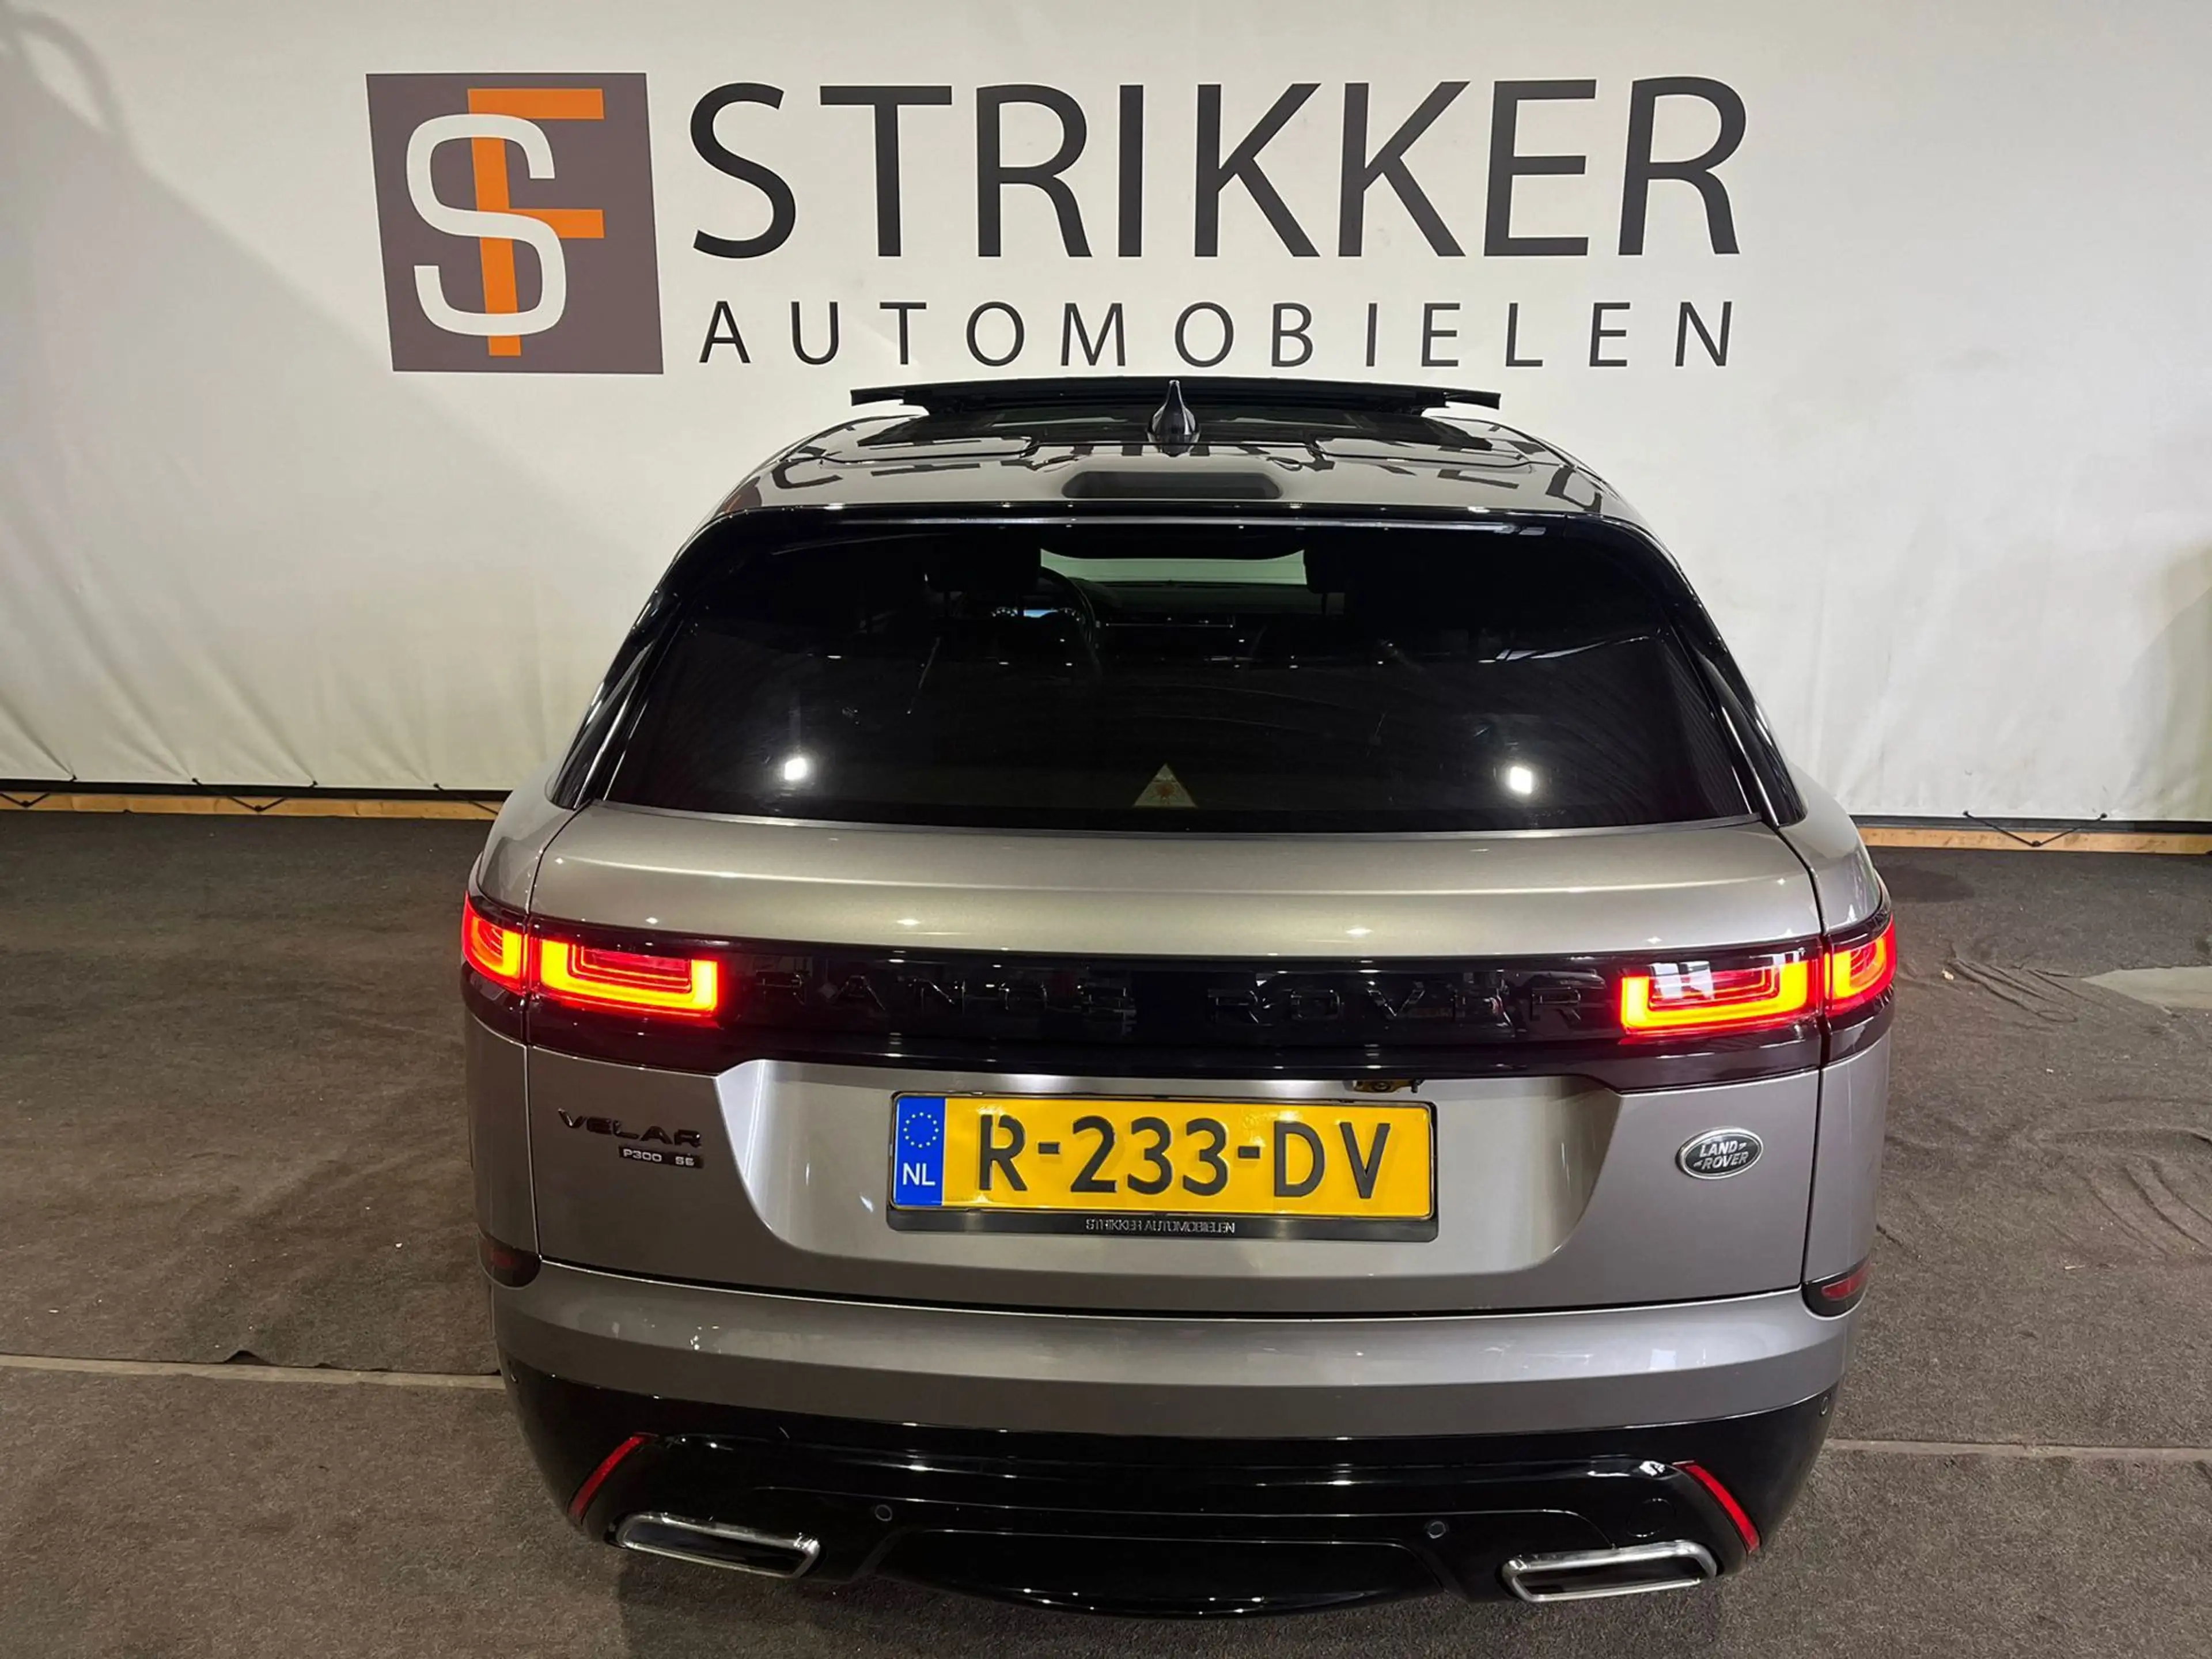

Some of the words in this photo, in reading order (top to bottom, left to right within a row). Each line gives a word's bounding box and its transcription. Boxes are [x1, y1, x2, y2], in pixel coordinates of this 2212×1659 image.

[690, 75, 1747, 259] STRIKKER
[698, 300, 1733, 368] AUTOMOBIELEN
[557, 1107, 702, 1148] VELAR
[623, 1148, 662, 1162] P300
[978, 1113, 1391, 1199] R-233-DV
[1699, 1140, 1738, 1158] LAND
[1701, 1151, 1749, 1171] ROVER
[902, 1161, 936, 1187] NL
[1086, 1218, 1143, 1231] STRIKKER
[1144, 1219, 1236, 1234] AUTOMOBIELEN
